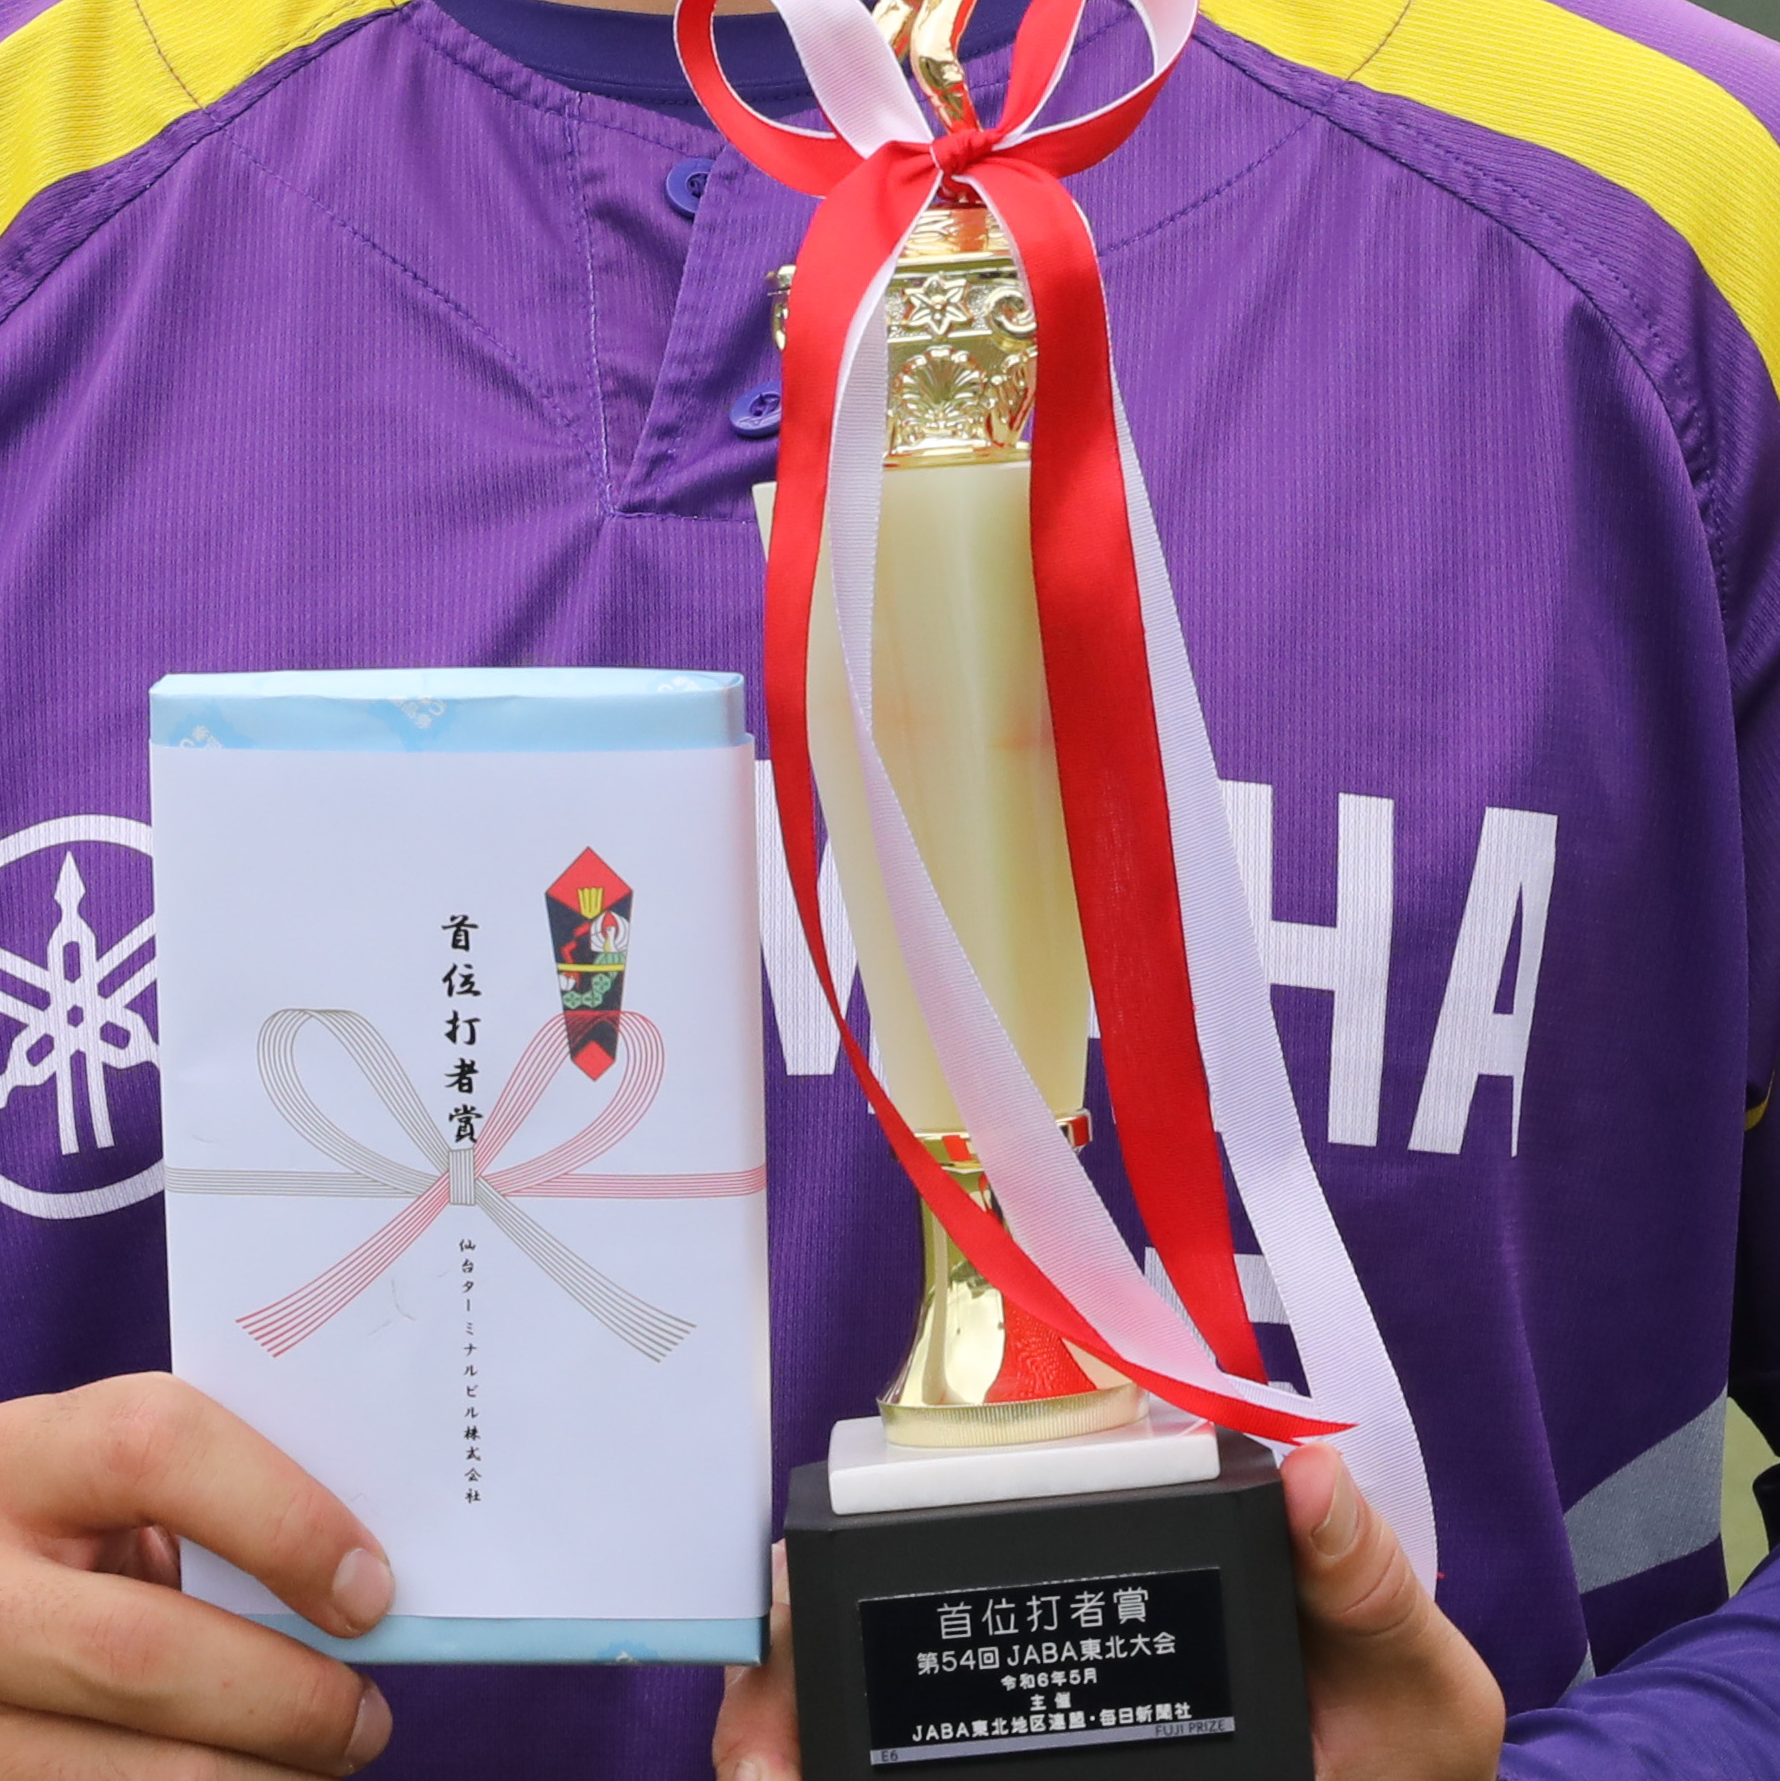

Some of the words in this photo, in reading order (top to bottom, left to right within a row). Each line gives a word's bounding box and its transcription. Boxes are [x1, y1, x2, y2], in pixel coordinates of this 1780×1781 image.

[441, 914, 484, 1145] 首位打者賞
[459, 1238, 482, 1504] 仙台ターミナルビル株式会社
[937, 1586, 1149, 1639] 首位打者賞
[1000, 1667, 1098, 1691] 令和6年5月
[1155, 1724, 1184, 1737] FUJI
[1188, 1718, 1225, 1734] PRIZE
[881, 1750, 899, 1762] E6
